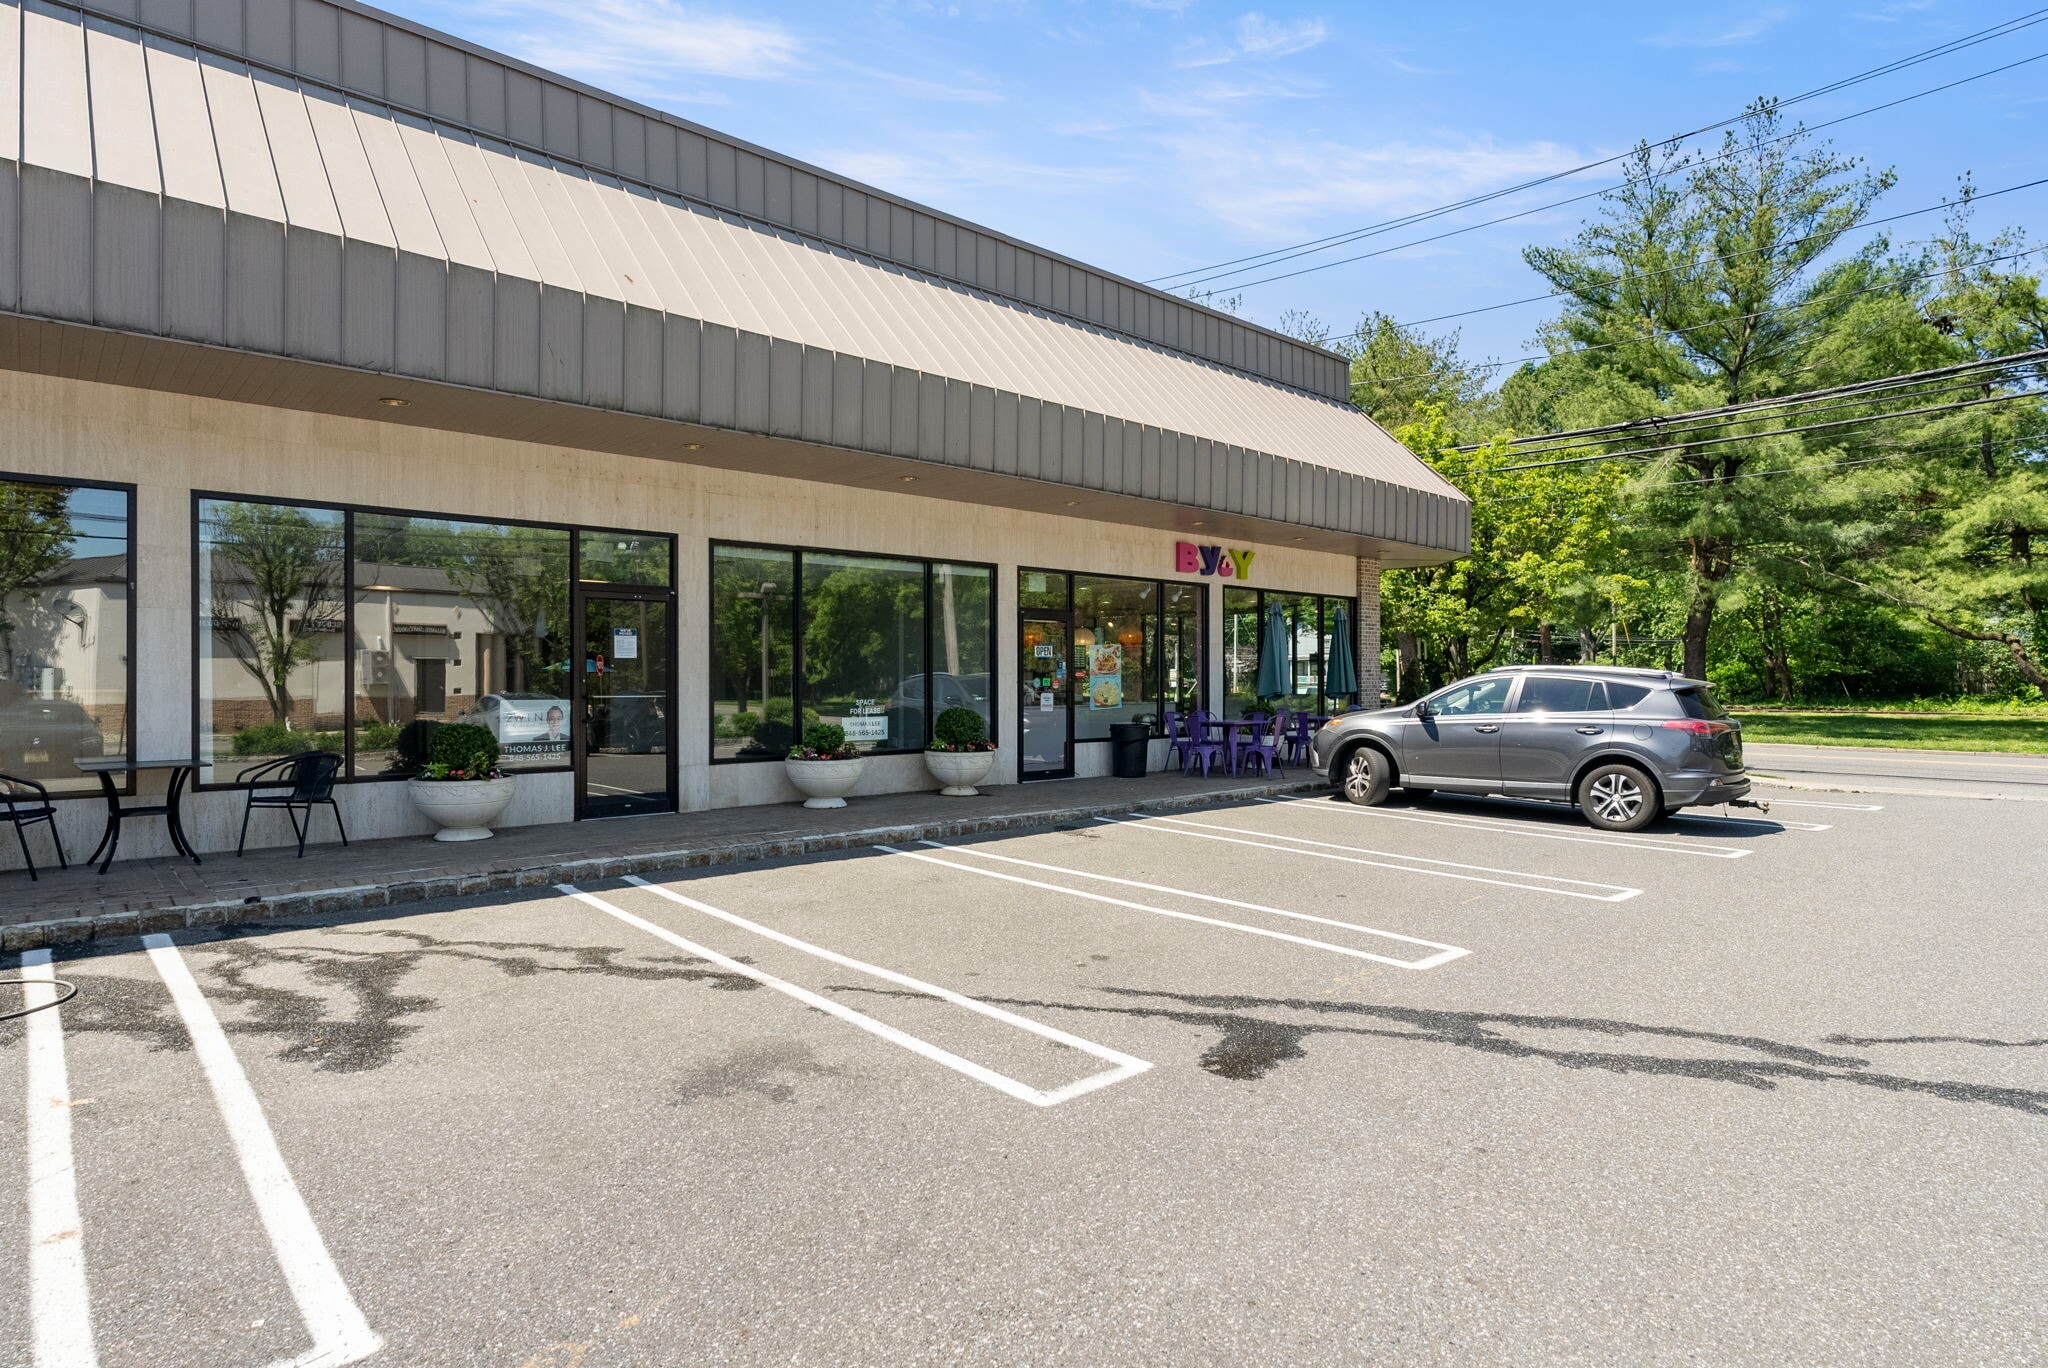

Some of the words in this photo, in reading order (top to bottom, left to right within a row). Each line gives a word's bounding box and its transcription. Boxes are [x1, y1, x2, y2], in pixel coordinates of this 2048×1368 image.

[1036, 646, 1051, 656] OPEN
[862, 707, 881, 715] LEASE
[504, 745, 542, 753] THOMAS
[551, 744, 566, 752] LEE
[509, 753, 561, 761] 848-565-1425
